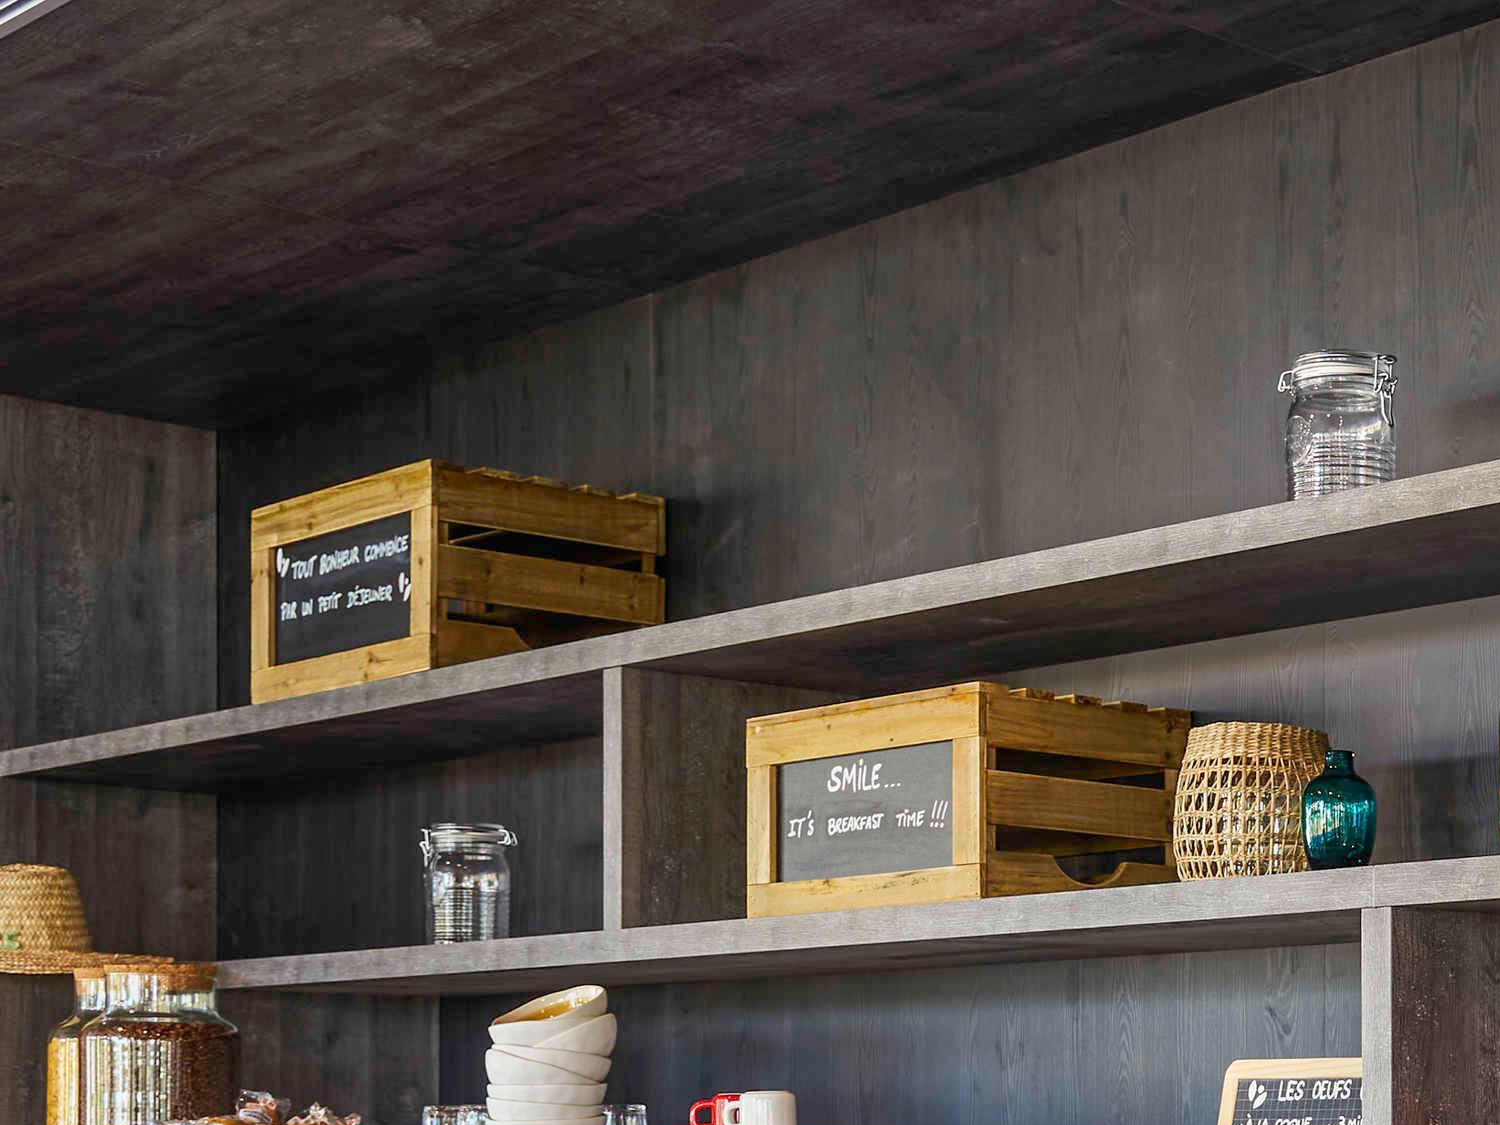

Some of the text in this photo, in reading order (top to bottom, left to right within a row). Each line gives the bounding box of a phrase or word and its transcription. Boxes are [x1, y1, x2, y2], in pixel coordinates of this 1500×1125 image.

[291, 534, 409, 580] TOUT BONHEUR COMMENCE
[280, 585, 393, 621] PAR UN PETIT DÉJEUNER
[787, 810, 815, 838] IT'S
[827, 813, 885, 836] BREAKFAST
[1278, 1078, 1353, 1102] LES OEUFS
